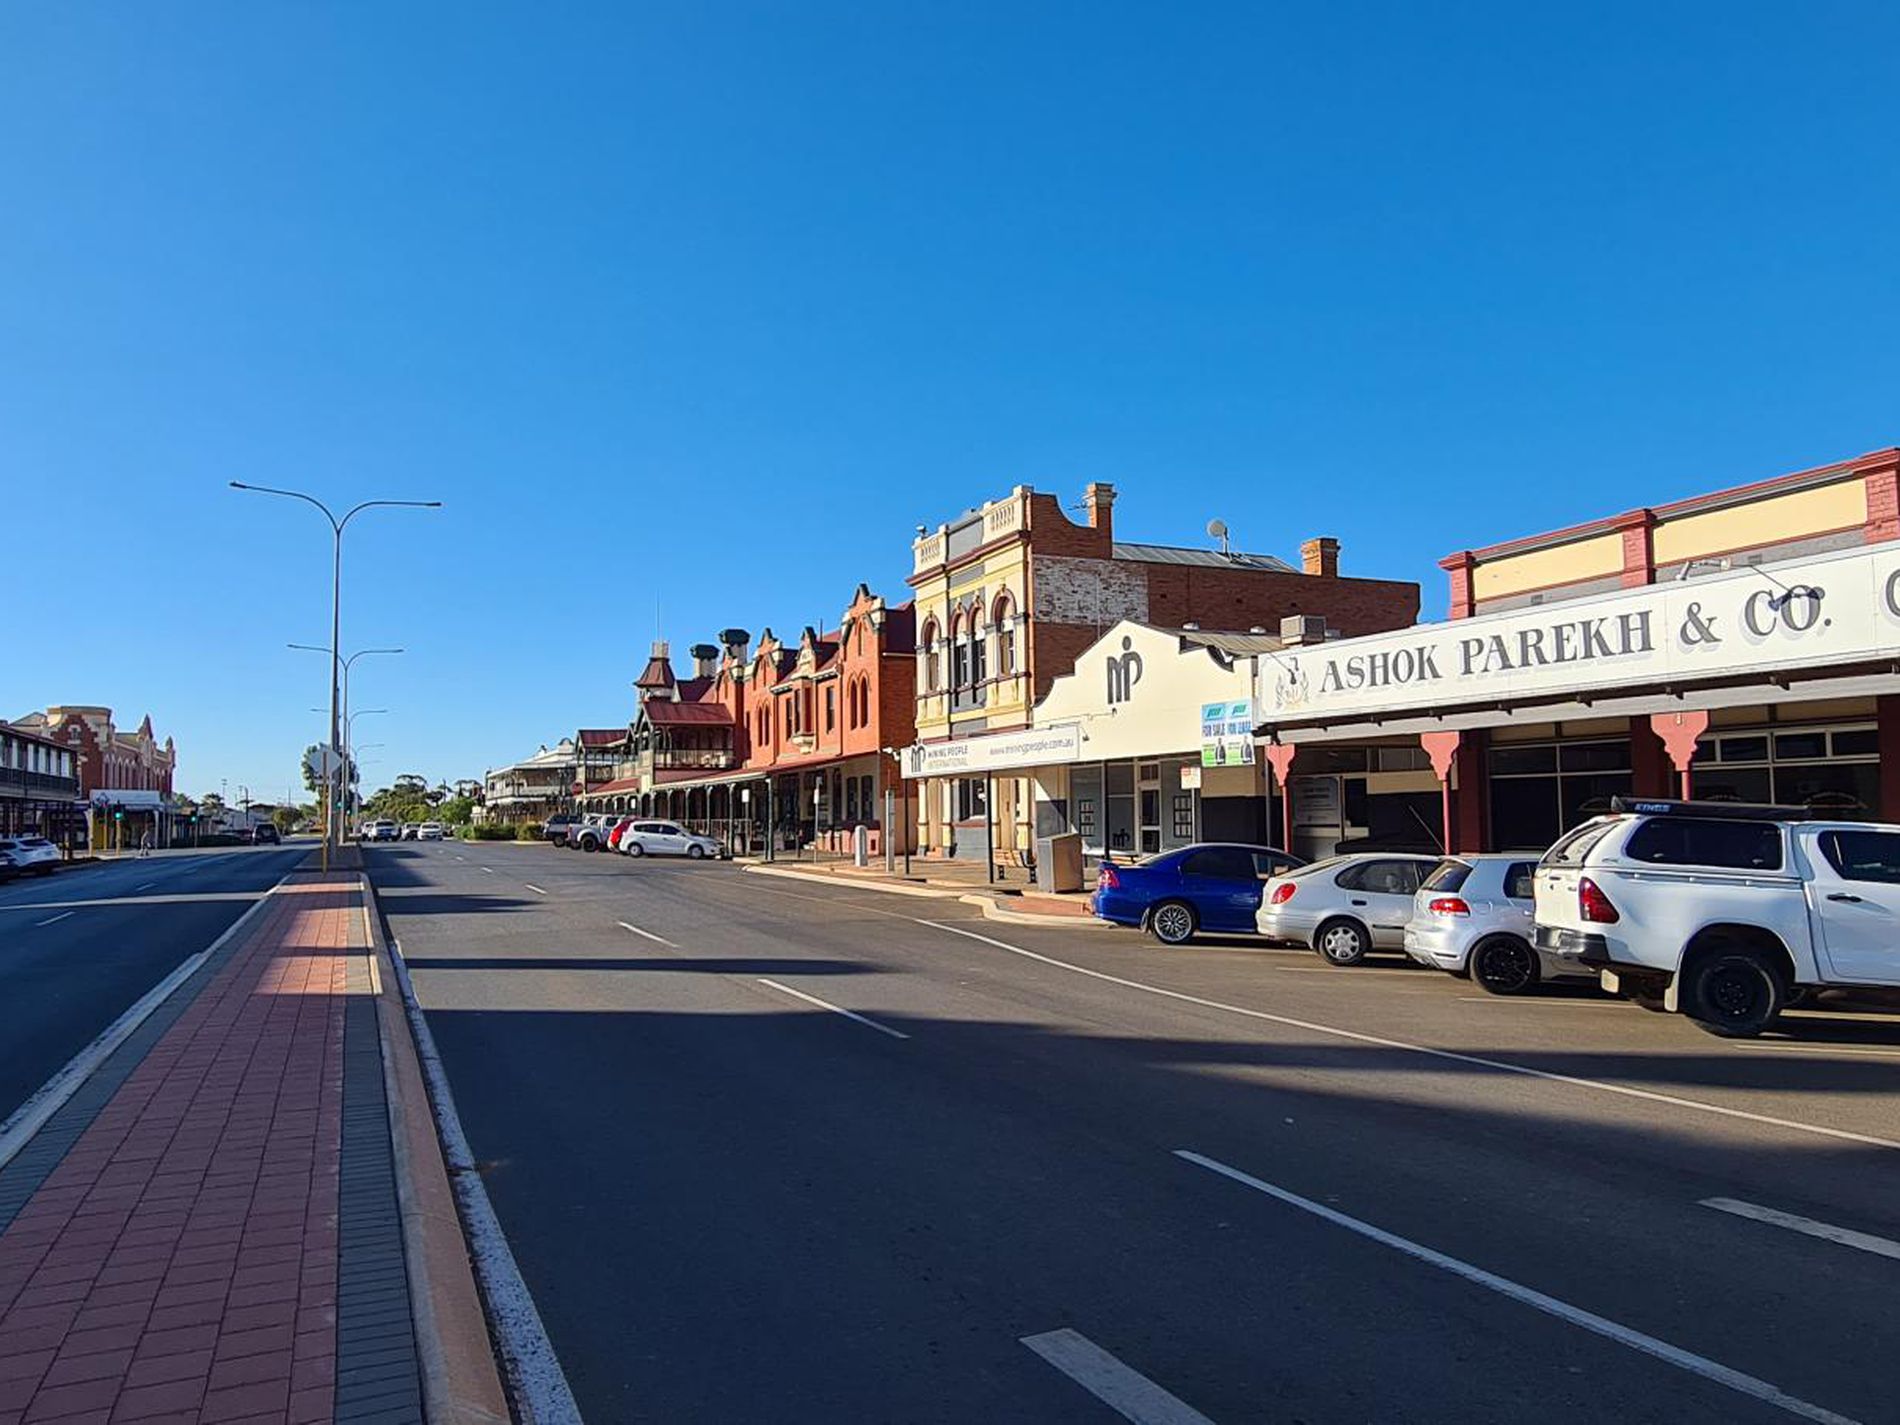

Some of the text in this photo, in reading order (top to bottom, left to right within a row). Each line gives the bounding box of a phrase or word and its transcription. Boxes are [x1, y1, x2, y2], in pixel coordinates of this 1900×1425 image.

[1319, 643, 1443, 693] ASHOK
[1460, 609, 1657, 676] PAREKH
[1679, 601, 1723, 646] &
[1743, 584, 1833, 637] CO.
